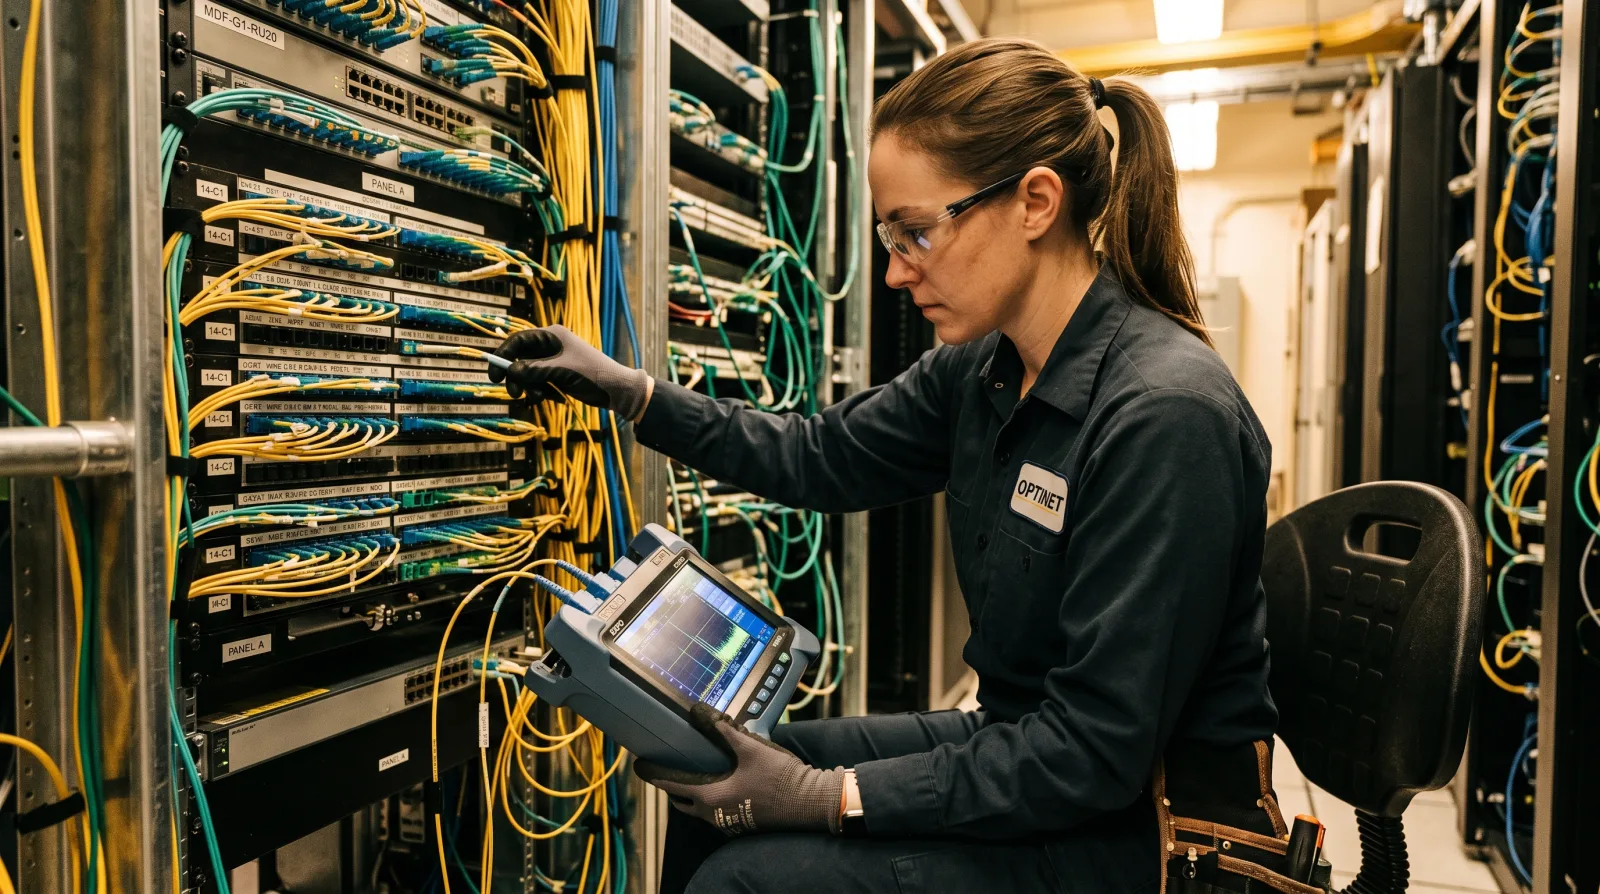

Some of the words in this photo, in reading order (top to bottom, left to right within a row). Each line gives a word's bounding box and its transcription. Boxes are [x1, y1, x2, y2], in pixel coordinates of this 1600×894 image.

[204, 4, 277, 43] MDF-G1-RU20
[200, 184, 224, 197] 14-C1
[371, 178, 398, 194] PANEL
[399, 186, 405, 196] A
[207, 230, 232, 242] 14-C1
[208, 326, 232, 336] 14-C1
[205, 373, 229, 382] 14-C1
[207, 414, 230, 424] 14-C1
[1017, 479, 1065, 512] OPTINET
[209, 548, 232, 560] 14-C1
[228, 642, 255, 656] PANEL
[258, 641, 265, 649] A
[381, 755, 400, 768] PANEL
